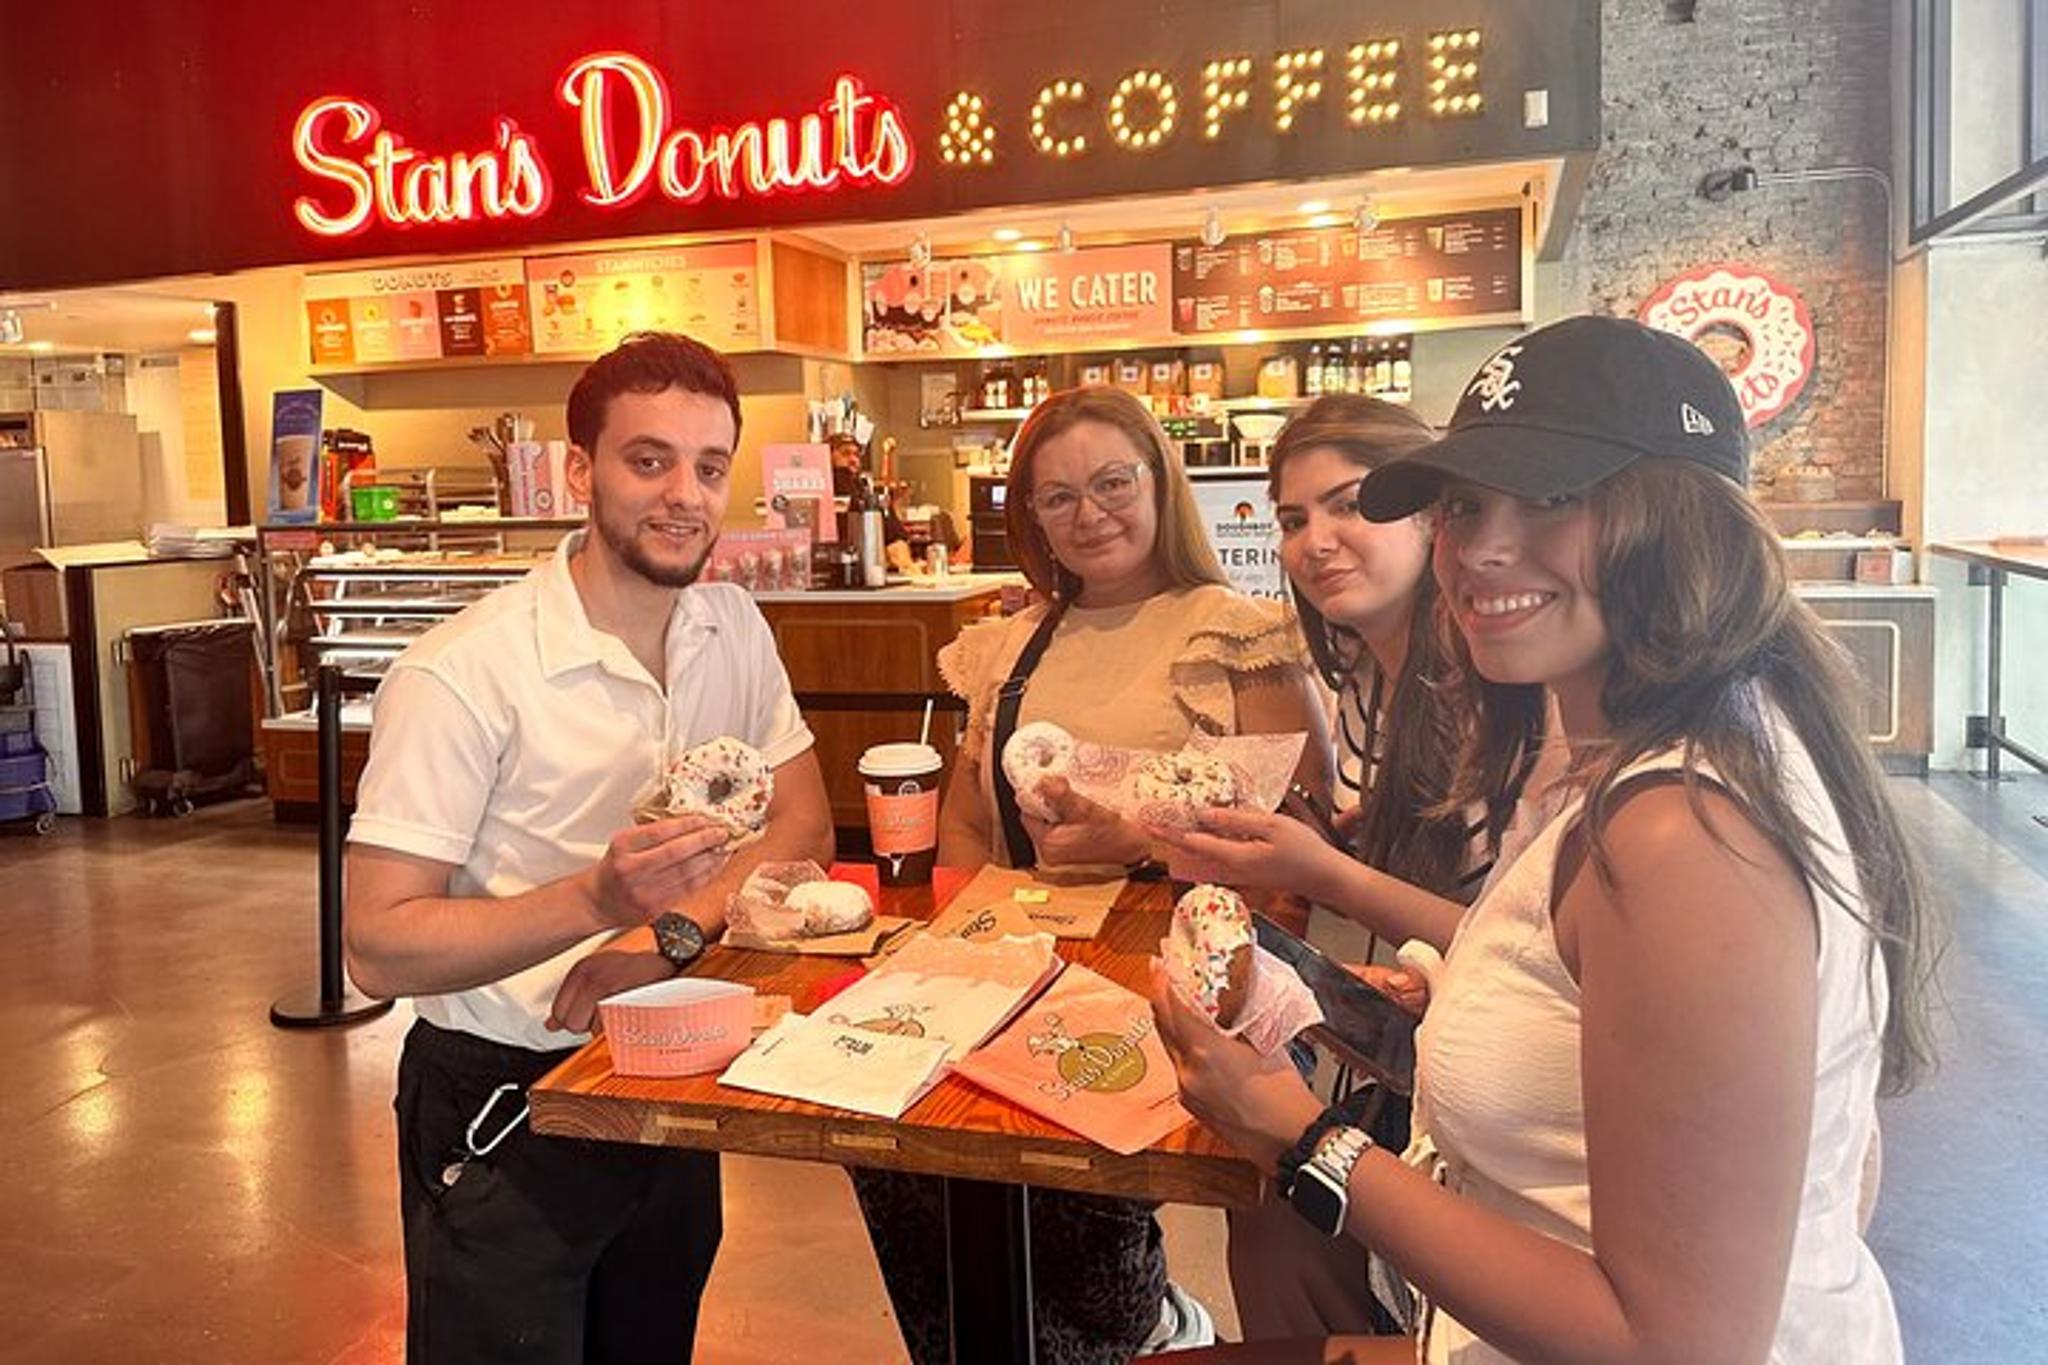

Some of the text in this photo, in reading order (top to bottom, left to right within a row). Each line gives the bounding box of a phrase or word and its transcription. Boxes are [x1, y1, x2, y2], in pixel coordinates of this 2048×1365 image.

[292, 27, 1485, 236] Stan's Donuts & COFFEE
[373, 271, 453, 291] DONUTS
[1017, 271, 1158, 312] WE CATER
[1669, 285, 1772, 327] Stan's
